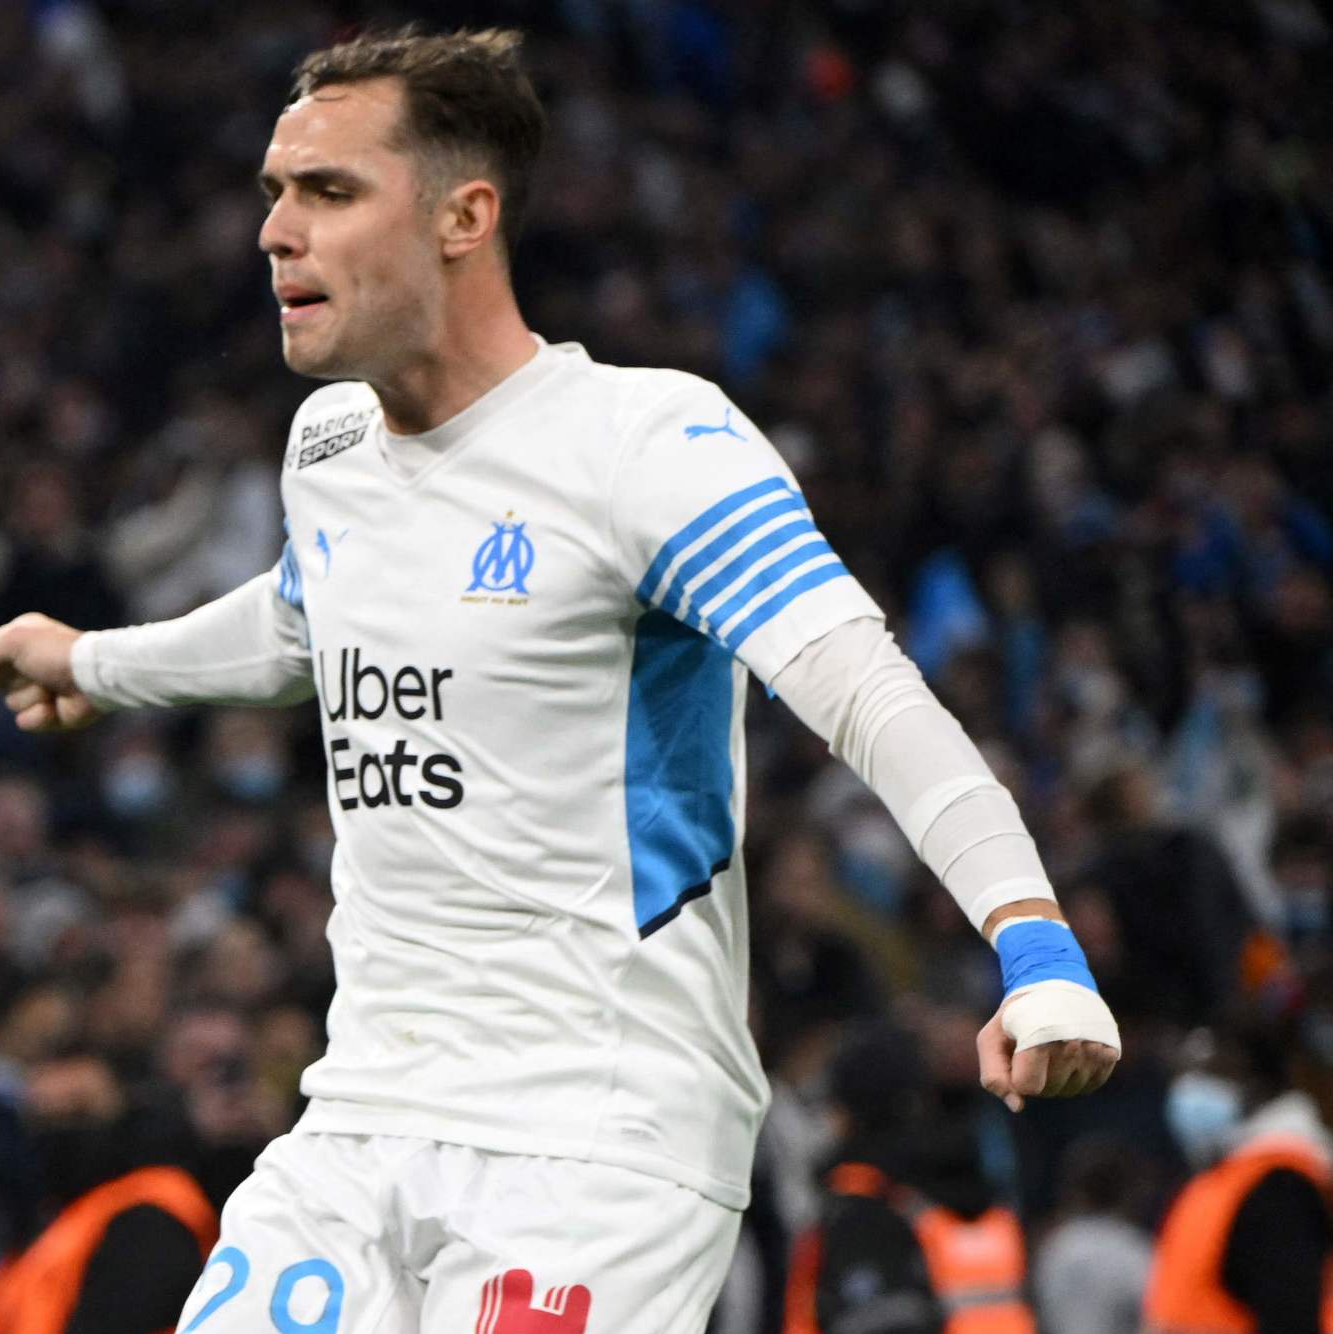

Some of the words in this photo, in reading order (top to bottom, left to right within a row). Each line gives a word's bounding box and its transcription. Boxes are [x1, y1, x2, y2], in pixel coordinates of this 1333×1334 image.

[298, 426, 367, 468] SPORT
[320, 648, 453, 722] Uber
[330, 738, 464, 811] Eats
